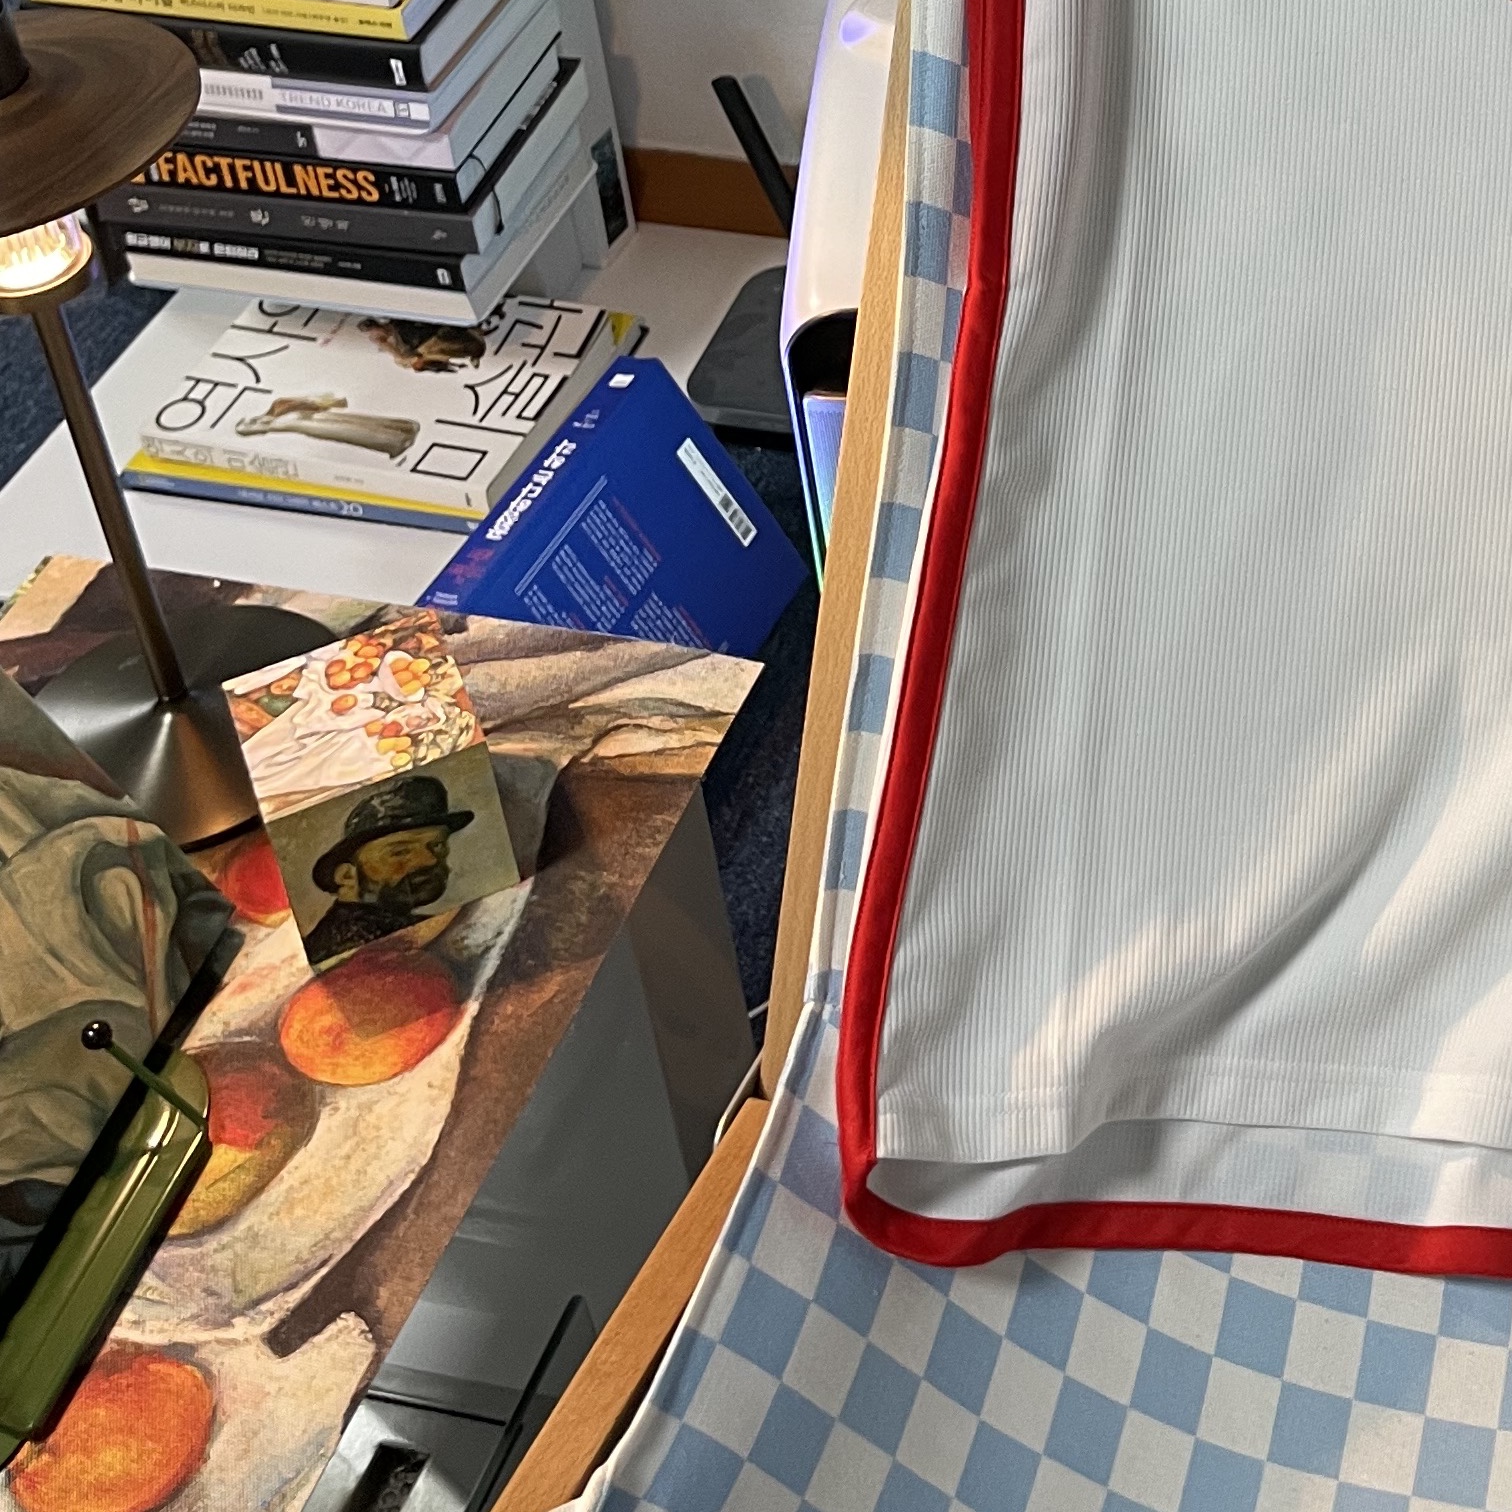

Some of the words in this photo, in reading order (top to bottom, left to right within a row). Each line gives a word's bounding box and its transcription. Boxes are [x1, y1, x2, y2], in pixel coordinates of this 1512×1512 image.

[335, 97, 388, 115] KOREA
[157, 150, 380, 203] FACTFULNESS
[410, 298, 607, 482] 미술관
